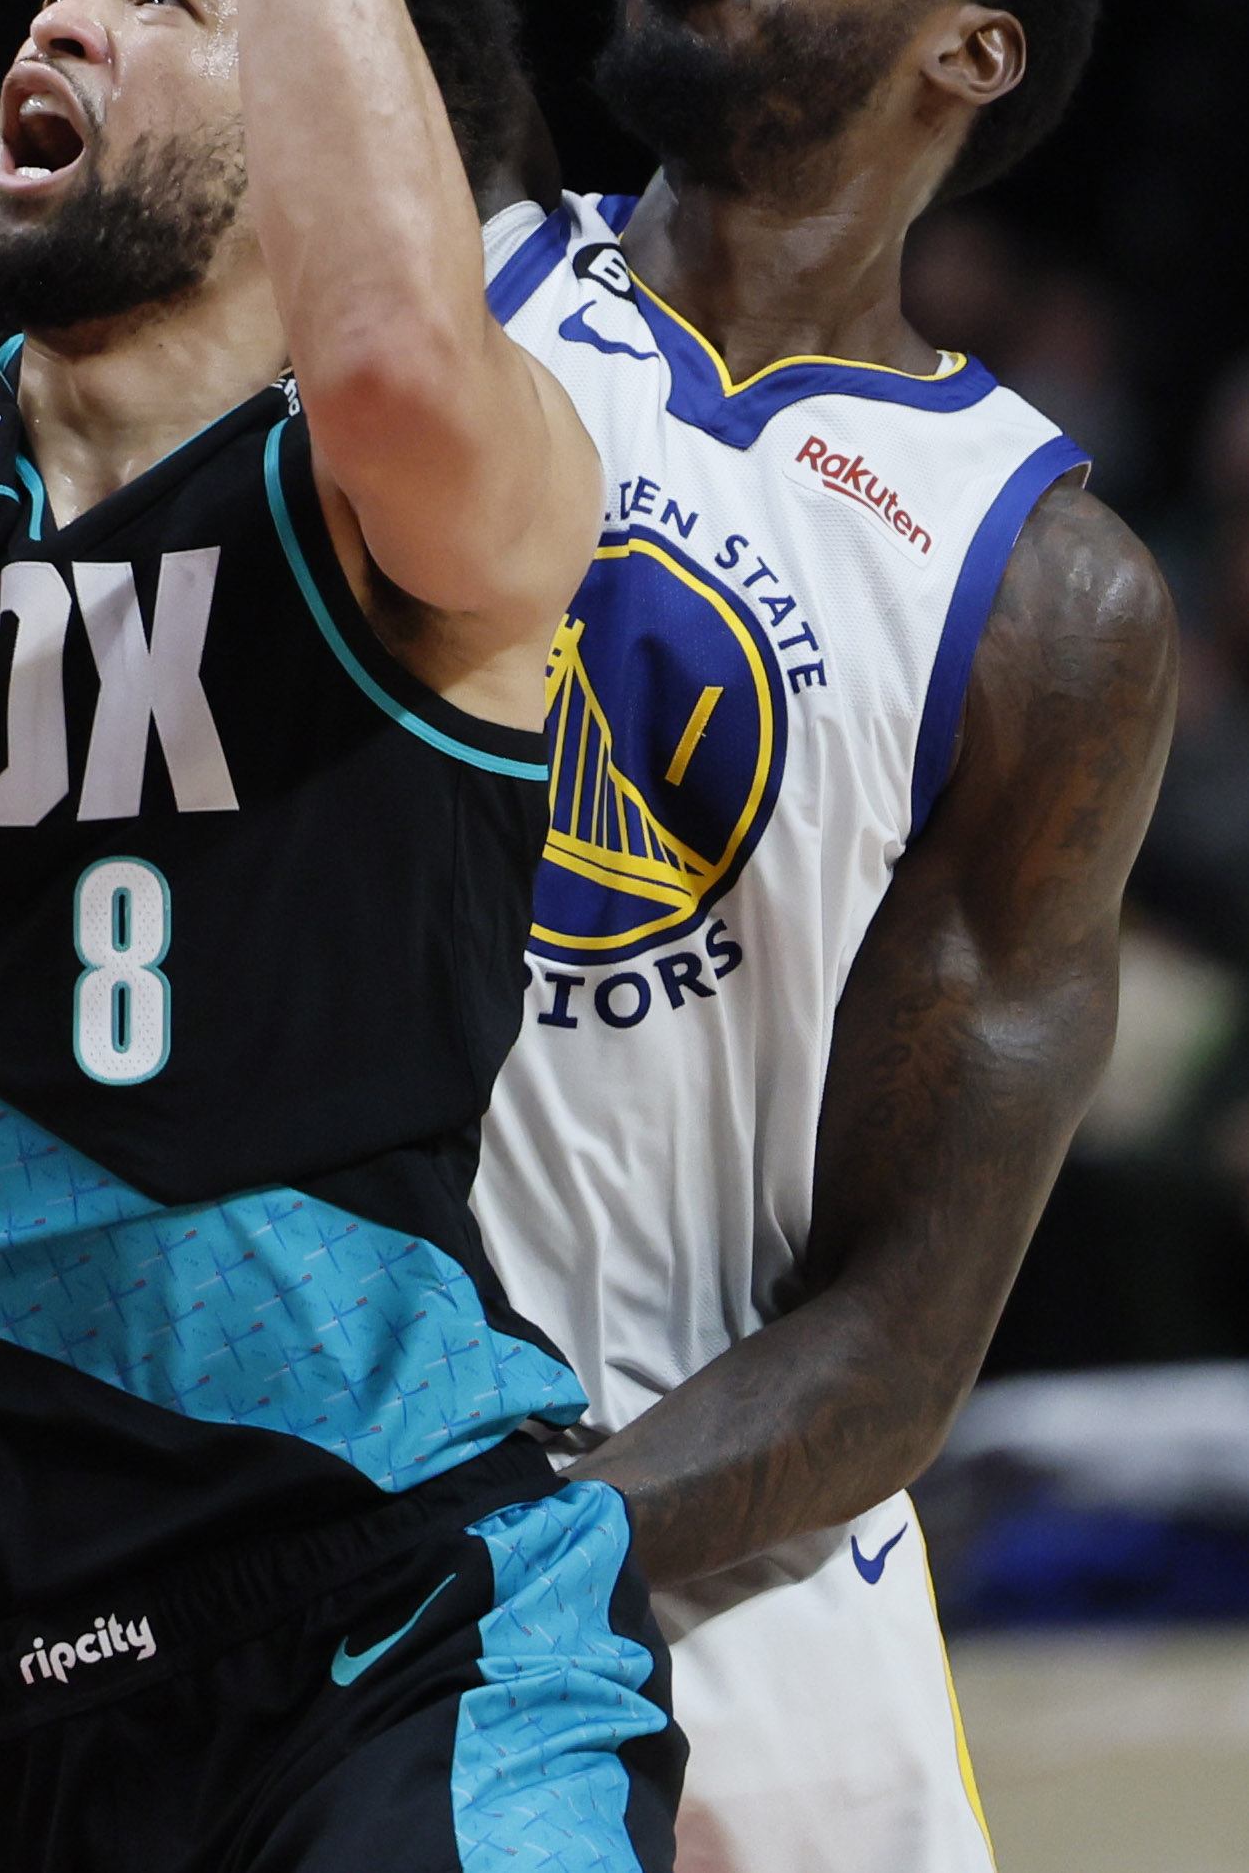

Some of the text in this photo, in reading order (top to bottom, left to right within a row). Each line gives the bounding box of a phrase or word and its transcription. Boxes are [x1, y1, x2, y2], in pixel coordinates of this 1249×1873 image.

[587, 248, 631, 293] 6
[794, 435, 932, 555] Rakuten
[714, 534, 827, 695] STATE
[73, 855, 171, 1086] 8
[524, 918, 743, 1029] IORS
[19, 1613, 157, 1684] ripcity
